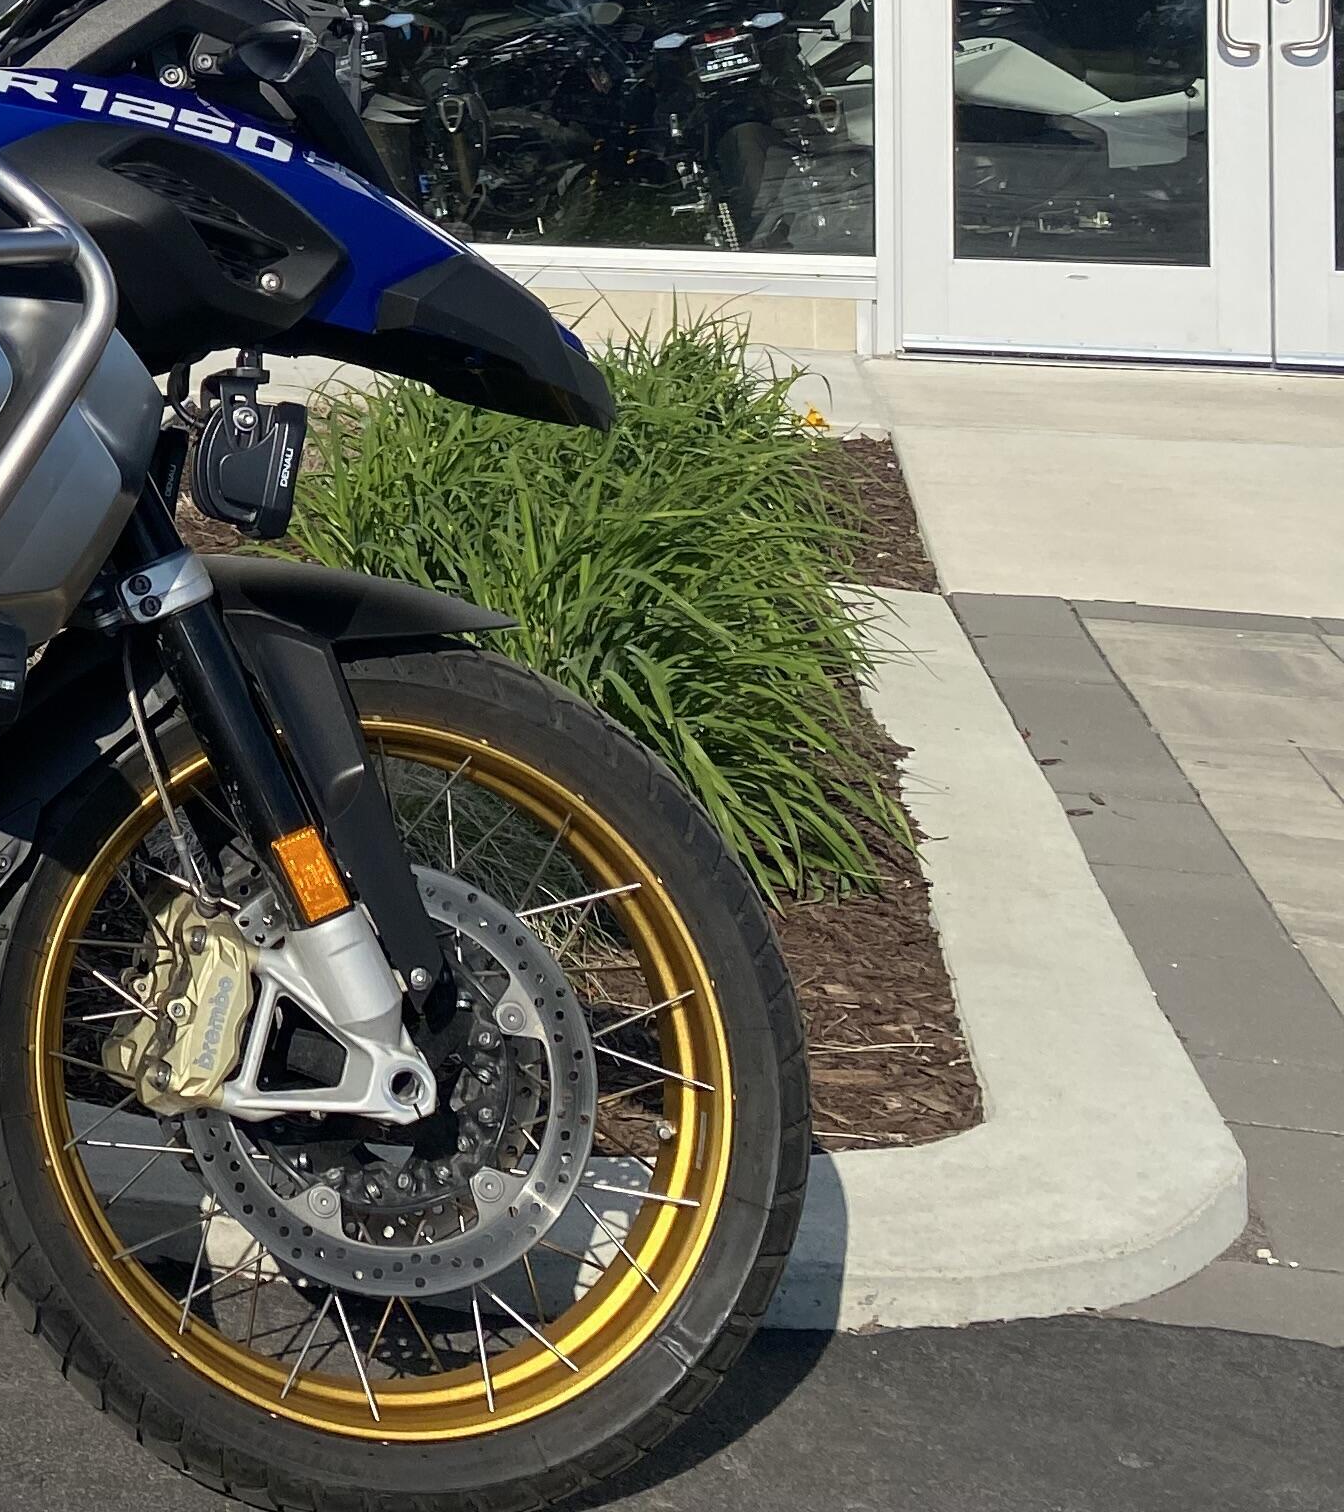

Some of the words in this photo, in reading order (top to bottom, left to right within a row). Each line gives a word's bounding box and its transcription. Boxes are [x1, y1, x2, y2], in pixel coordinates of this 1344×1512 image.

[72, 83, 294, 163] 1250
[280, 447, 294, 488] DENALI
[193, 976, 234, 1071] brembo
